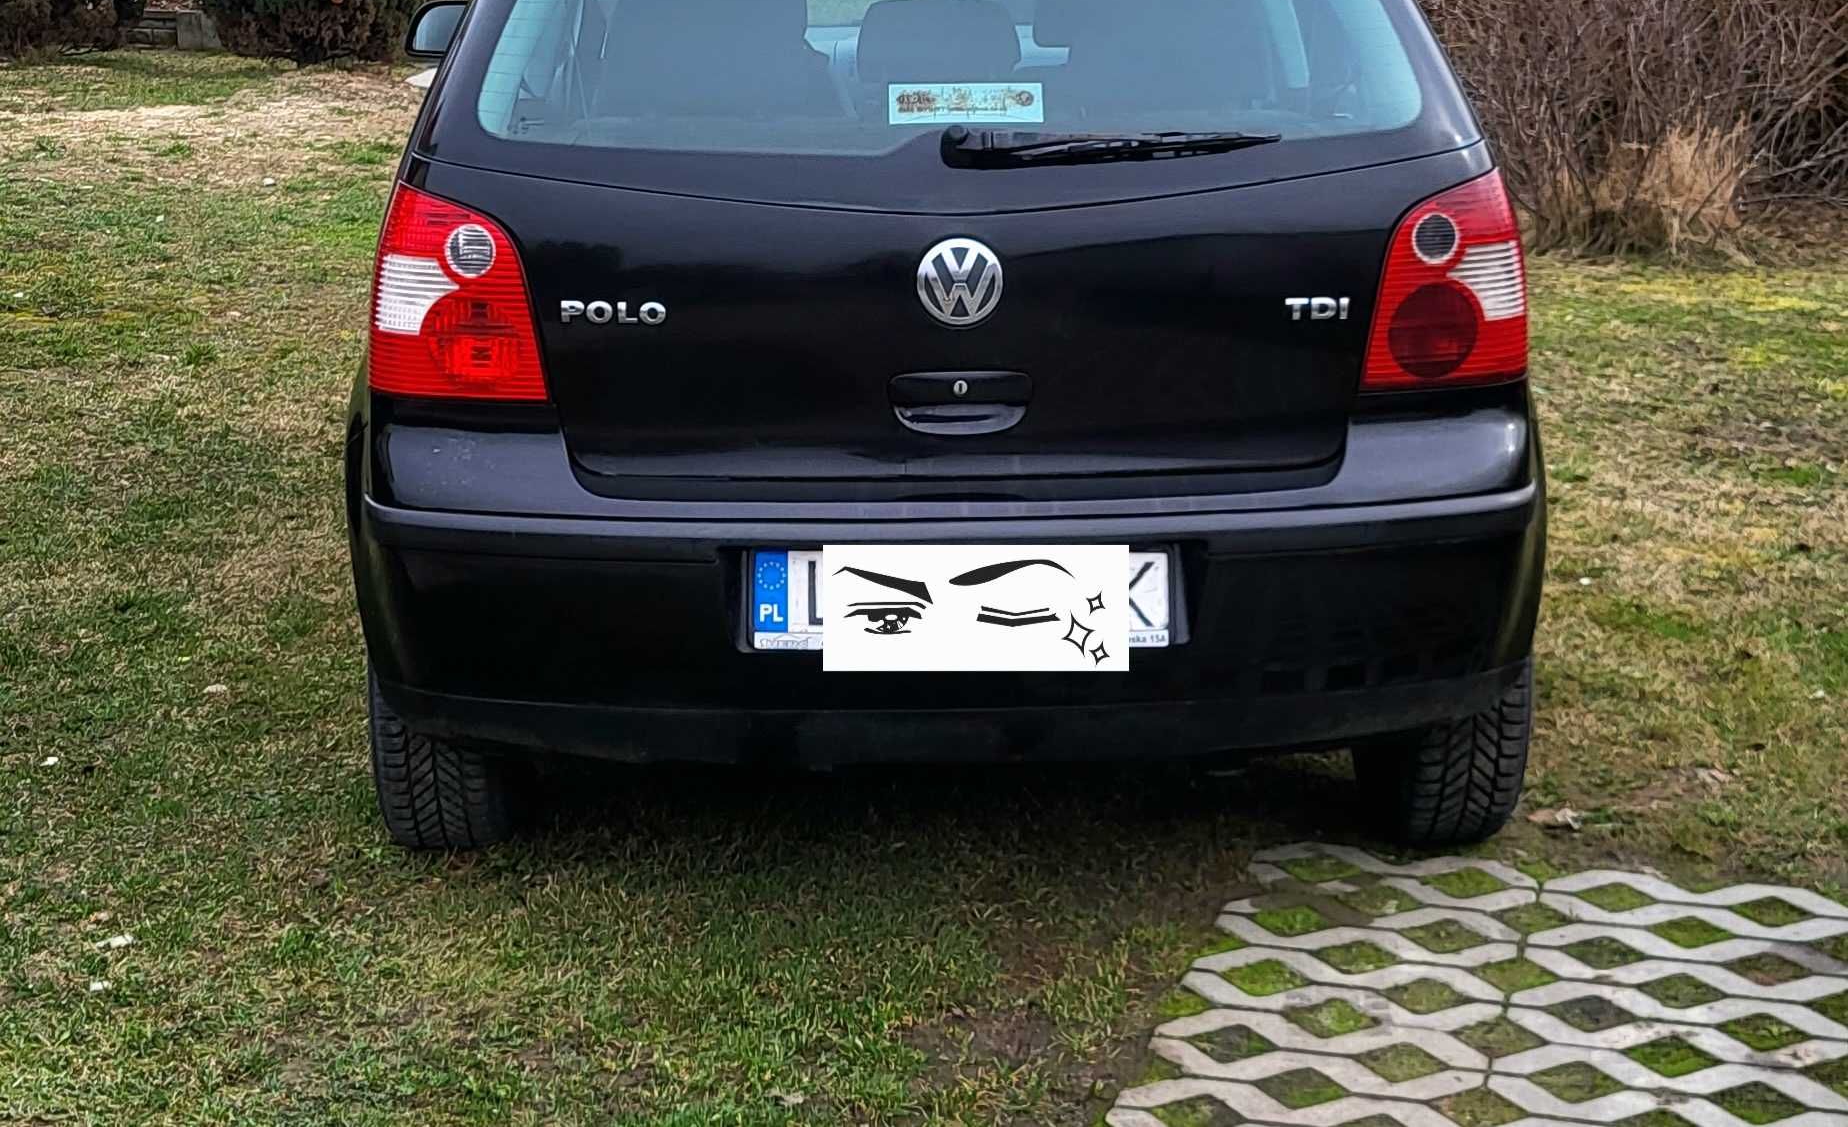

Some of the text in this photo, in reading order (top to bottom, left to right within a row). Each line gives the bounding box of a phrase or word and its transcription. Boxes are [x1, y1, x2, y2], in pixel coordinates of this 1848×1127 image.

[560, 300, 667, 325] POLO
[1284, 296, 1350, 320] TDI
[759, 603, 784, 622] PL
